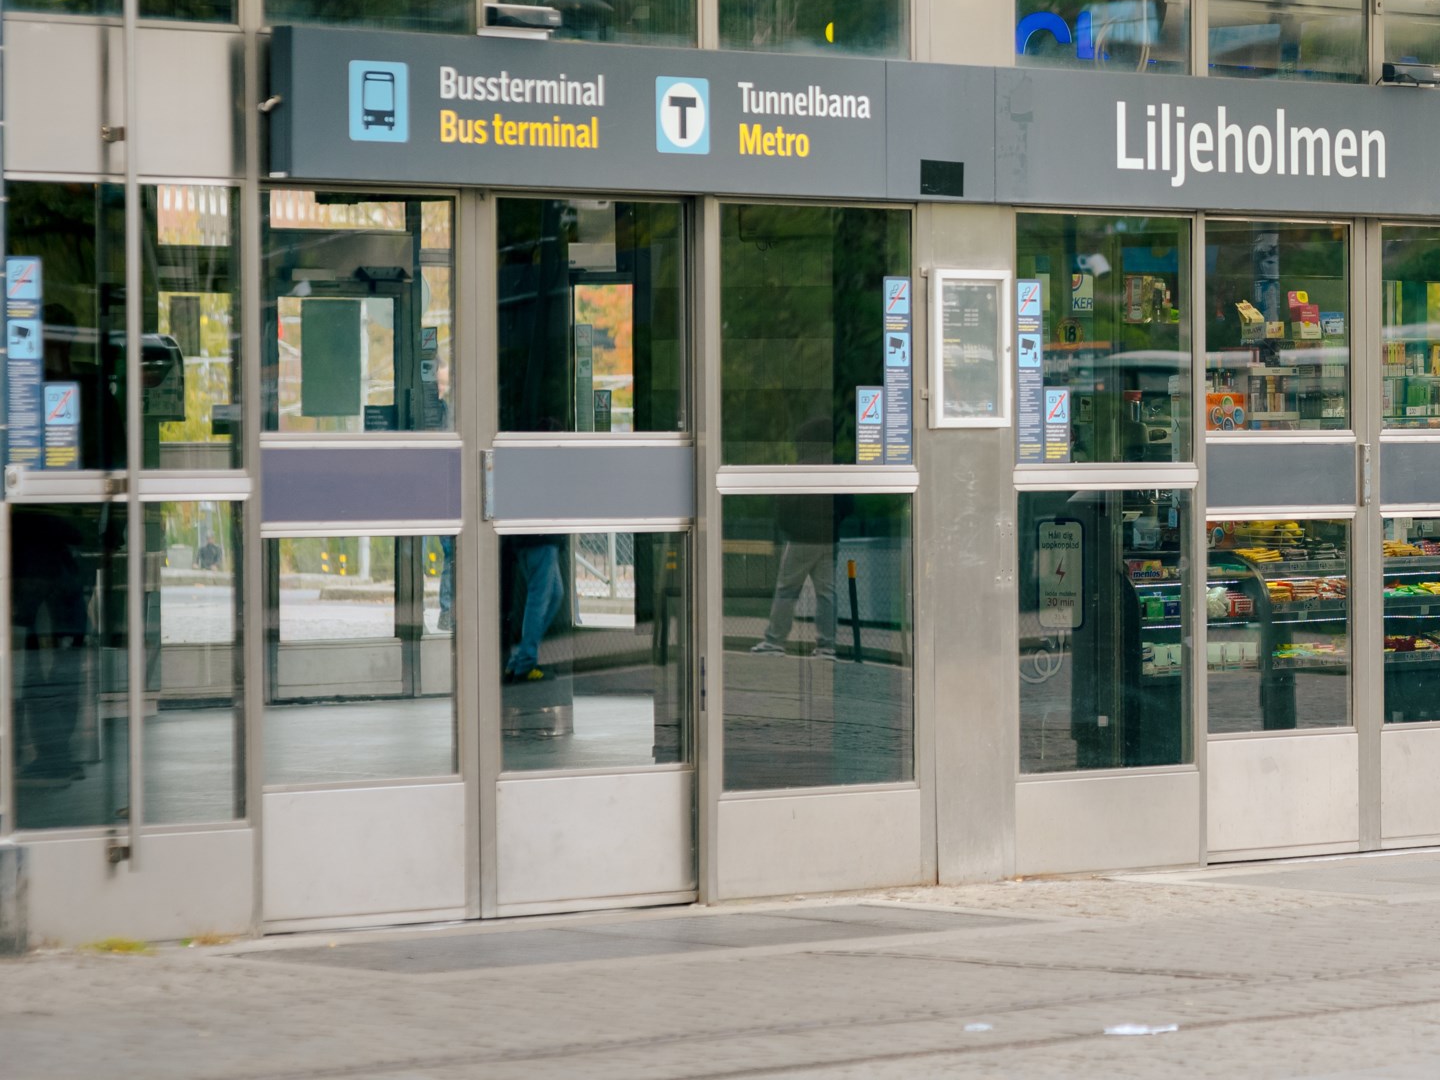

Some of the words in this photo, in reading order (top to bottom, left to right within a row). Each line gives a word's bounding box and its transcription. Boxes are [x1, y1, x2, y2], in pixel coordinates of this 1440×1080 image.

[440, 66, 604, 106] Bussterminal
[738, 82, 871, 119] Tunnelbana
[440, 110, 488, 144] Bus
[493, 113, 599, 149] terminal
[668, 96, 697, 139] T
[739, 123, 810, 157] Metro
[1117, 101, 1386, 187] Liljeholmen
[1072, 297, 1093, 309] KER
[1063, 325, 1077, 343] 18
[1132, 571, 1161, 579] mentos
[1047, 597, 1058, 607] 30
[1060, 597, 1075, 607] min
